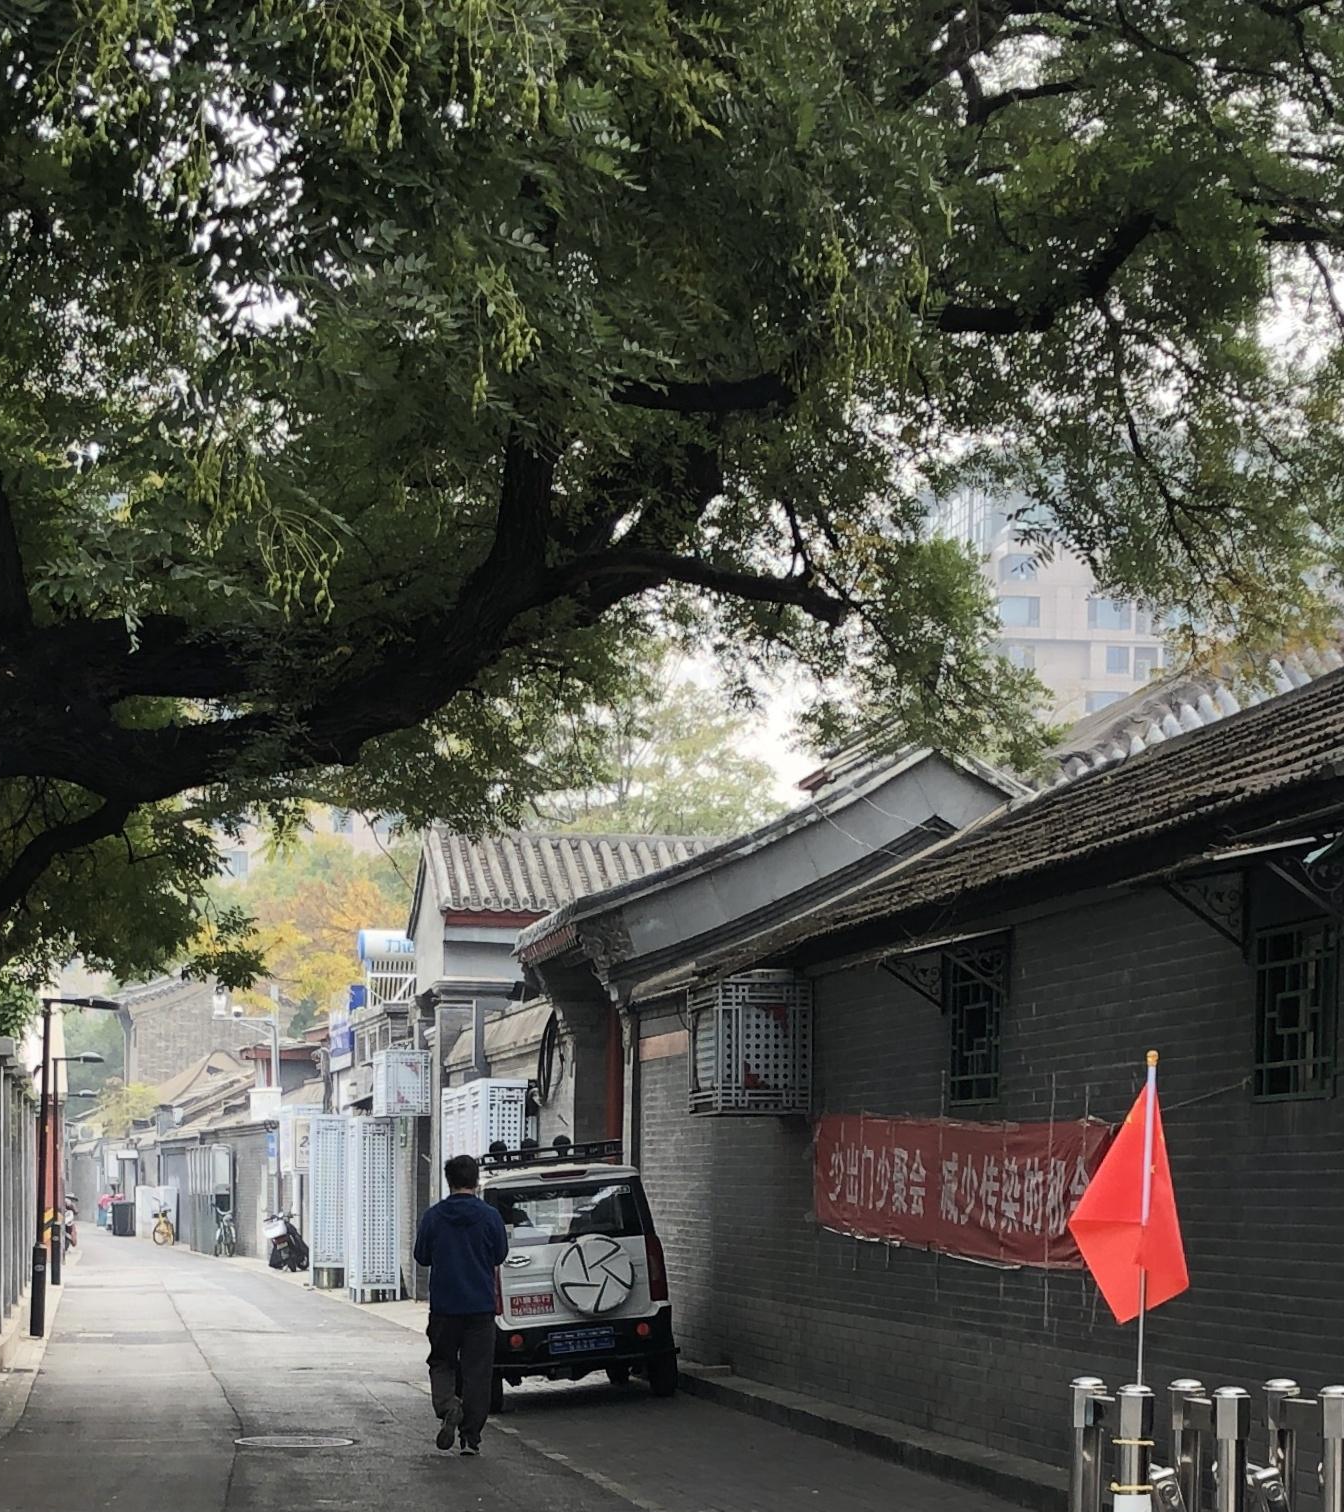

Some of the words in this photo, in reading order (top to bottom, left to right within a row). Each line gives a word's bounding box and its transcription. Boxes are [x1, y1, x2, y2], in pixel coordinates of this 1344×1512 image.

[829, 1142, 926, 1218] 少出门少聚会
